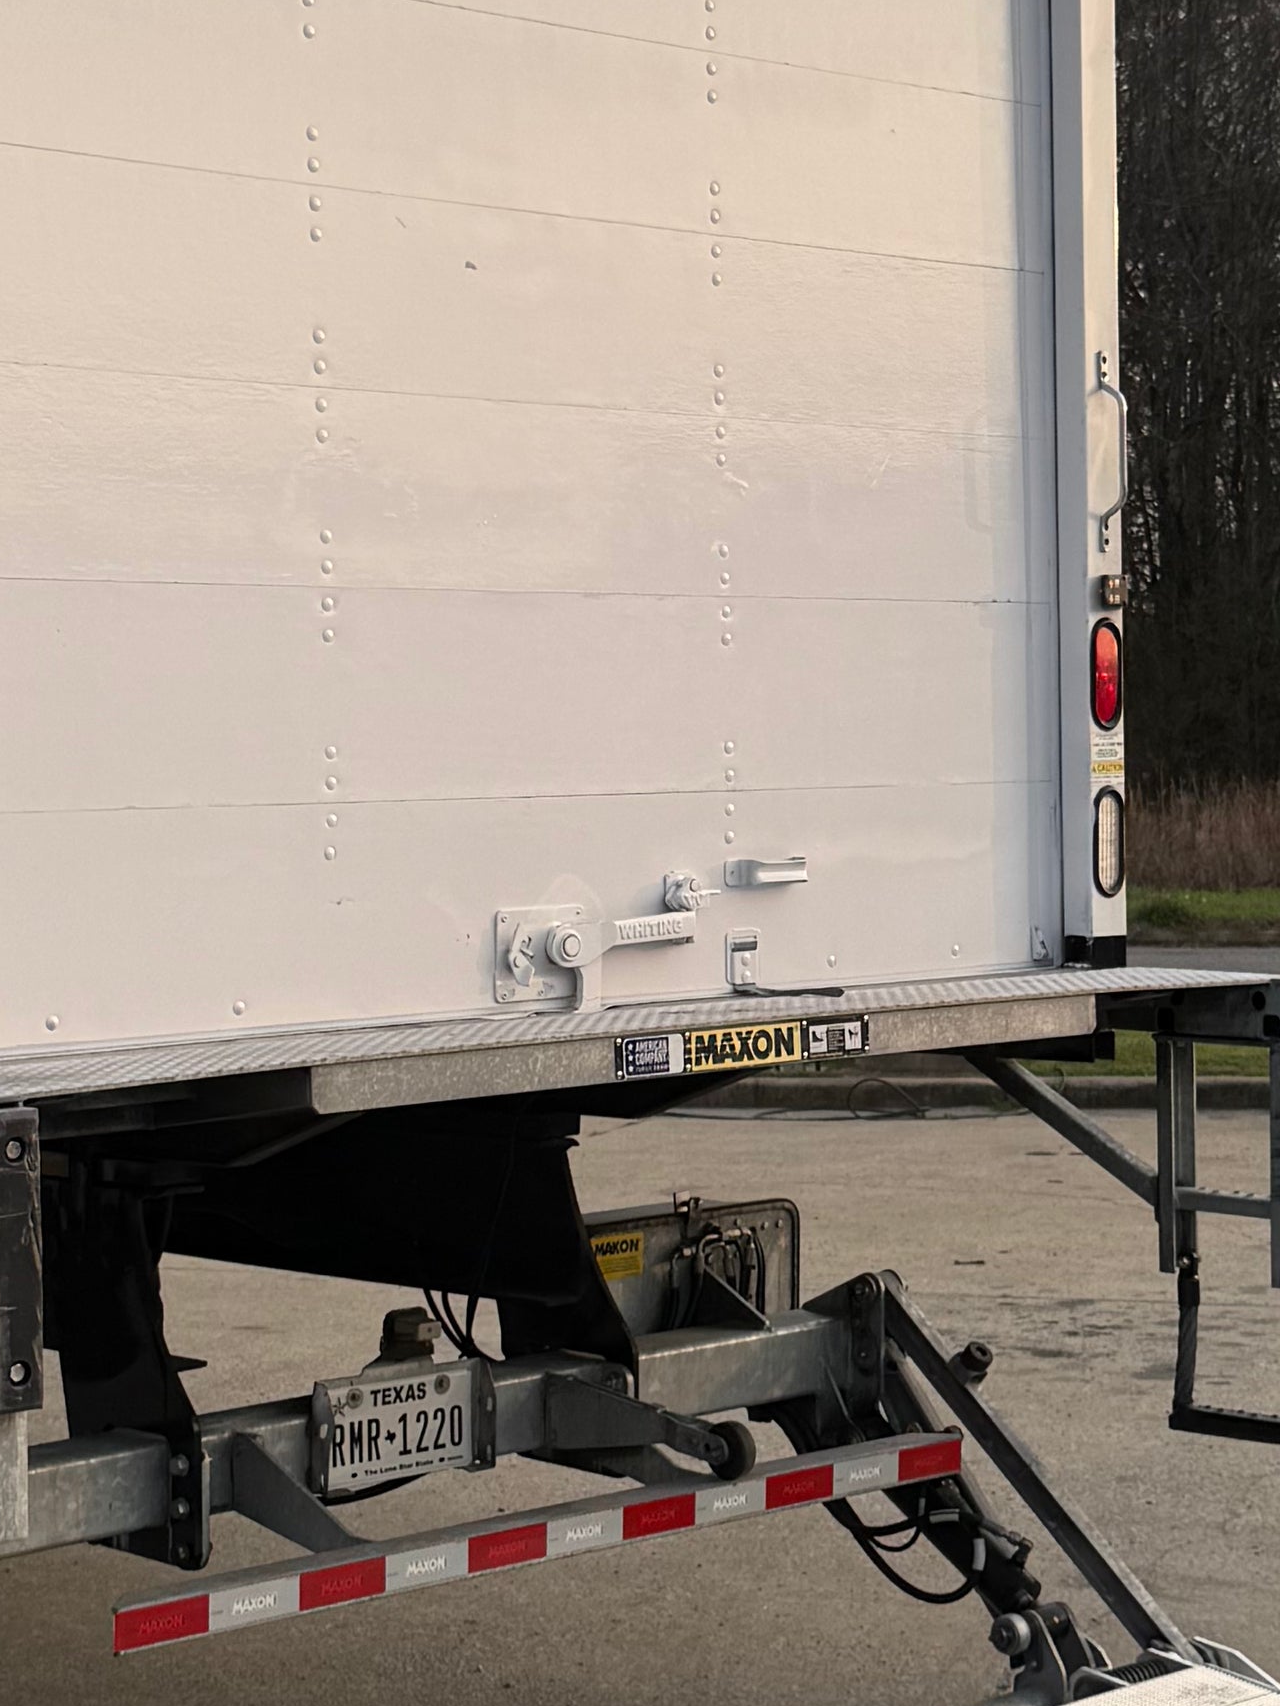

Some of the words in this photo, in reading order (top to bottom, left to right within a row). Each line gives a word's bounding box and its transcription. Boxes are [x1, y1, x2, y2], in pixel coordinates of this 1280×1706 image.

[617, 918, 684, 941] WHITING
[694, 1025, 795, 1067] MAXON
[595, 1238, 640, 1256] MAXON
[370, 1382, 427, 1407] TEXAS
[140, 1613, 184, 1634] MAXON
[232, 1592, 277, 1615] MAXON
[321, 1576, 361, 1594] MAXON
[406, 1555, 446, 1578] MAXON
[565, 1522, 603, 1544] MAXON
[713, 1493, 748, 1511] MAXON
[849, 1465, 881, 1482] MAXON
